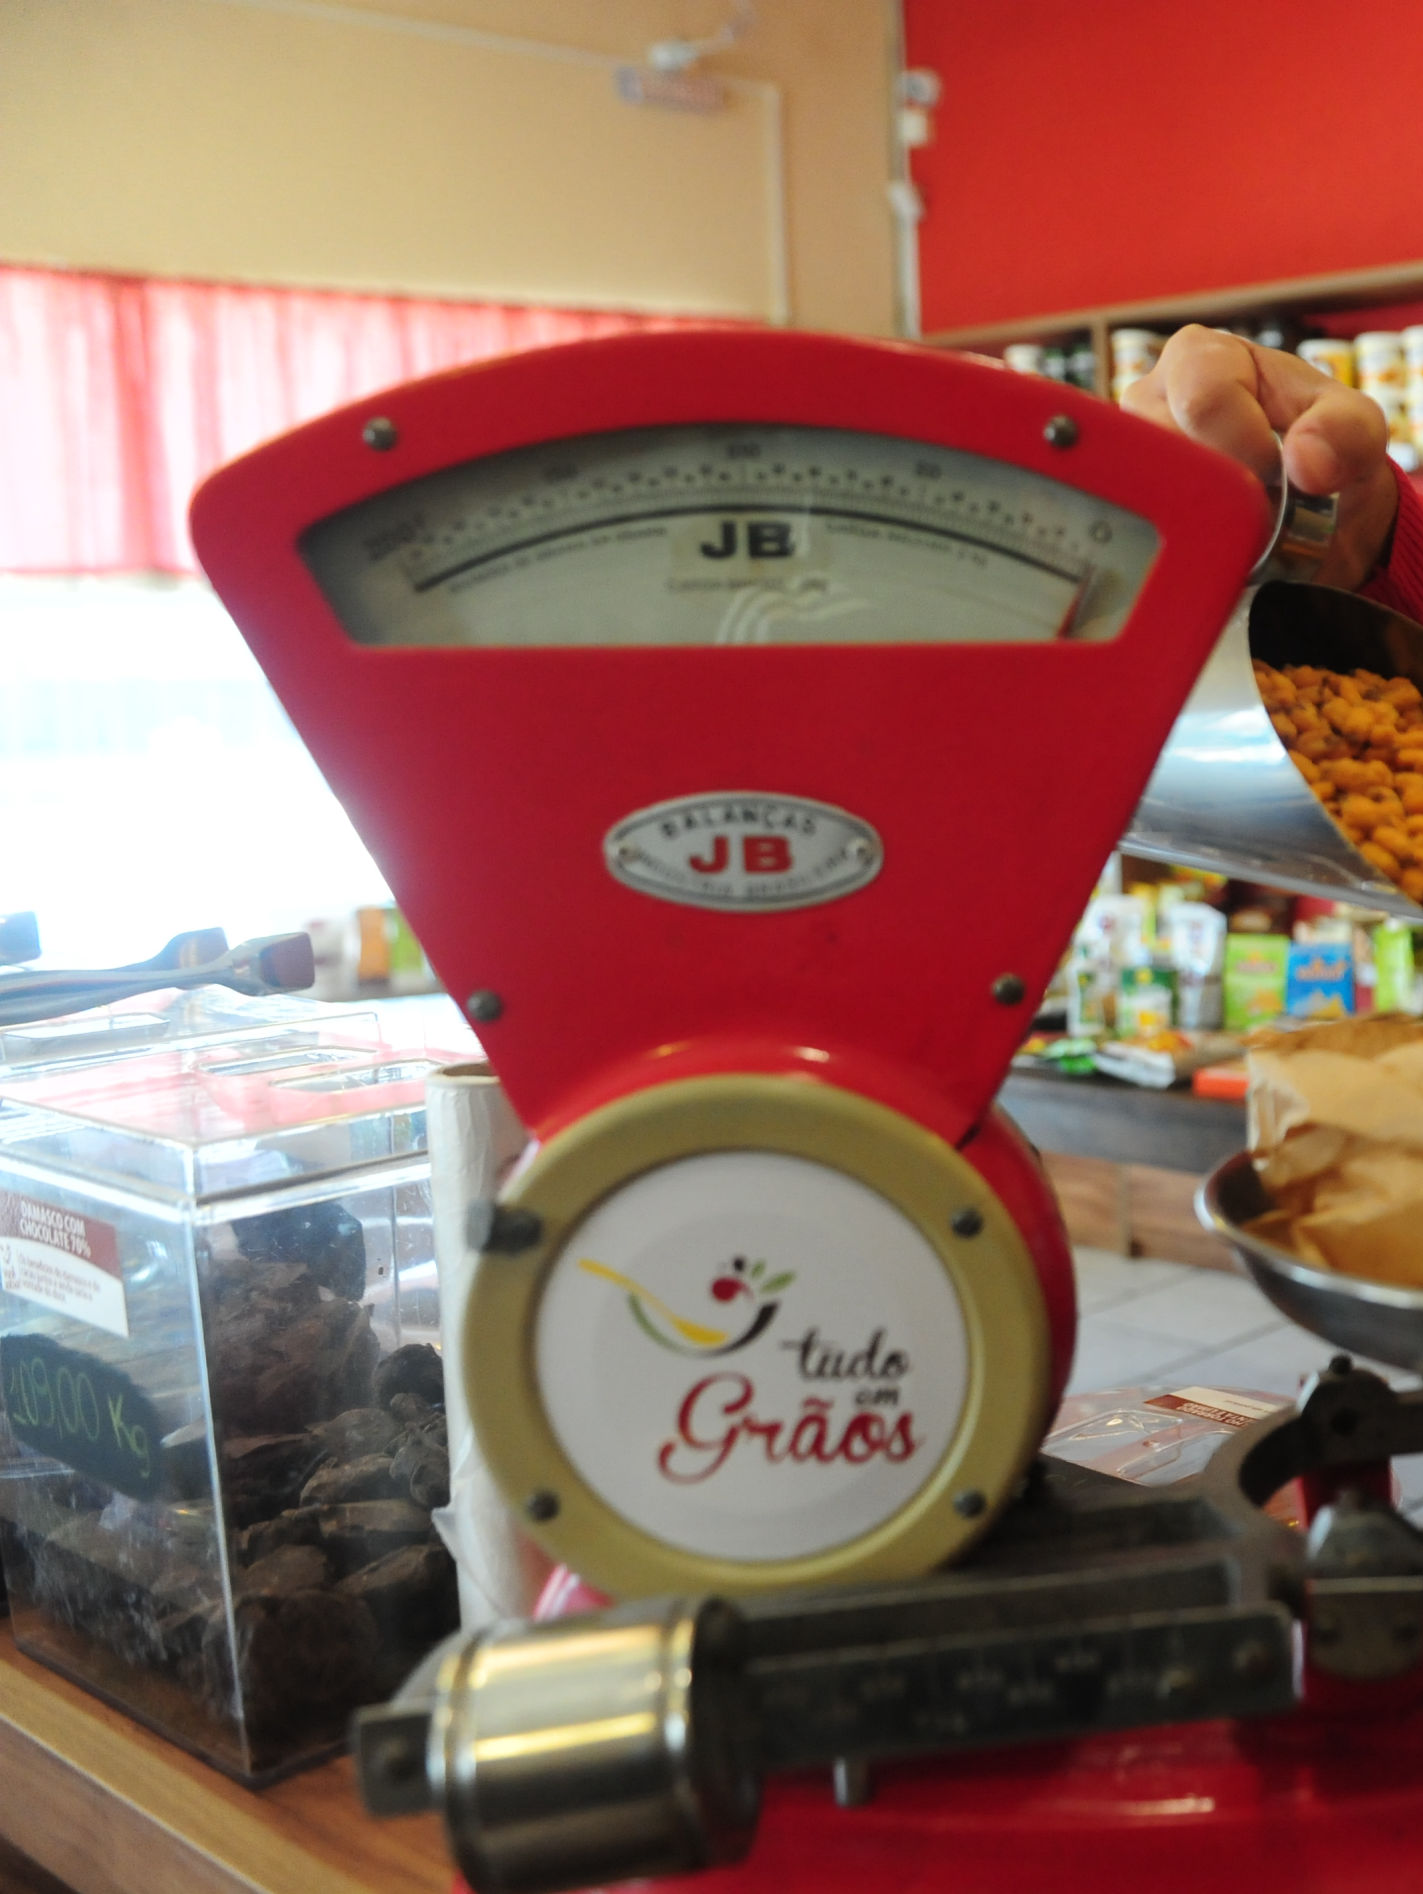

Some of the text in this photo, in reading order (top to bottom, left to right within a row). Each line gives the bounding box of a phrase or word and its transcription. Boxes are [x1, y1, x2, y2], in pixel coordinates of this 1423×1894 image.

[700, 519, 796, 560] JB
[689, 834, 795, 876] JB
[20, 1200, 87, 1238] DAMASCO COM
[20, 1218, 71, 1252] CHOCOLATE
[780, 1326, 909, 1379] tudo
[855, 1387, 900, 1405] em
[656, 1370, 925, 1486] Grãos
